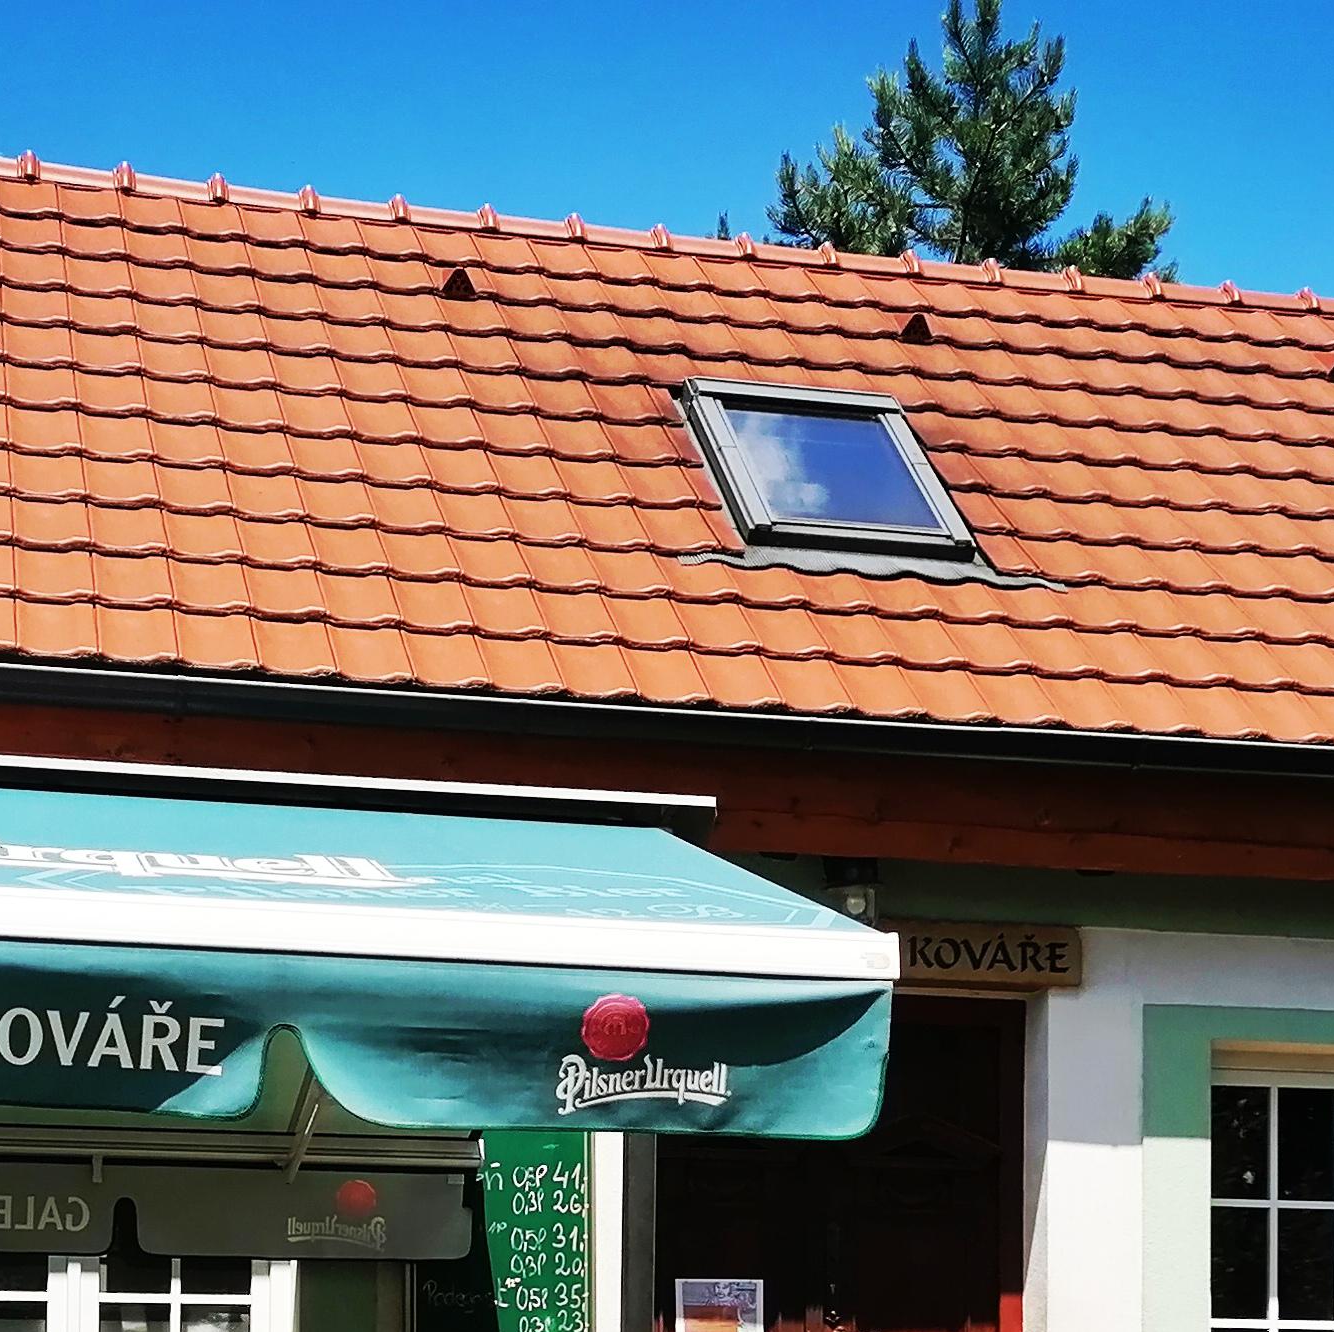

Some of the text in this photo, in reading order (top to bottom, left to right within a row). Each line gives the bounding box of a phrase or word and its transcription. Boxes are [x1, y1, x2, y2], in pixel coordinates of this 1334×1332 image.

[907, 932, 1070, 974] KOVÁŘE
[555, 1053, 729, 1116] Pilsner Urquell
